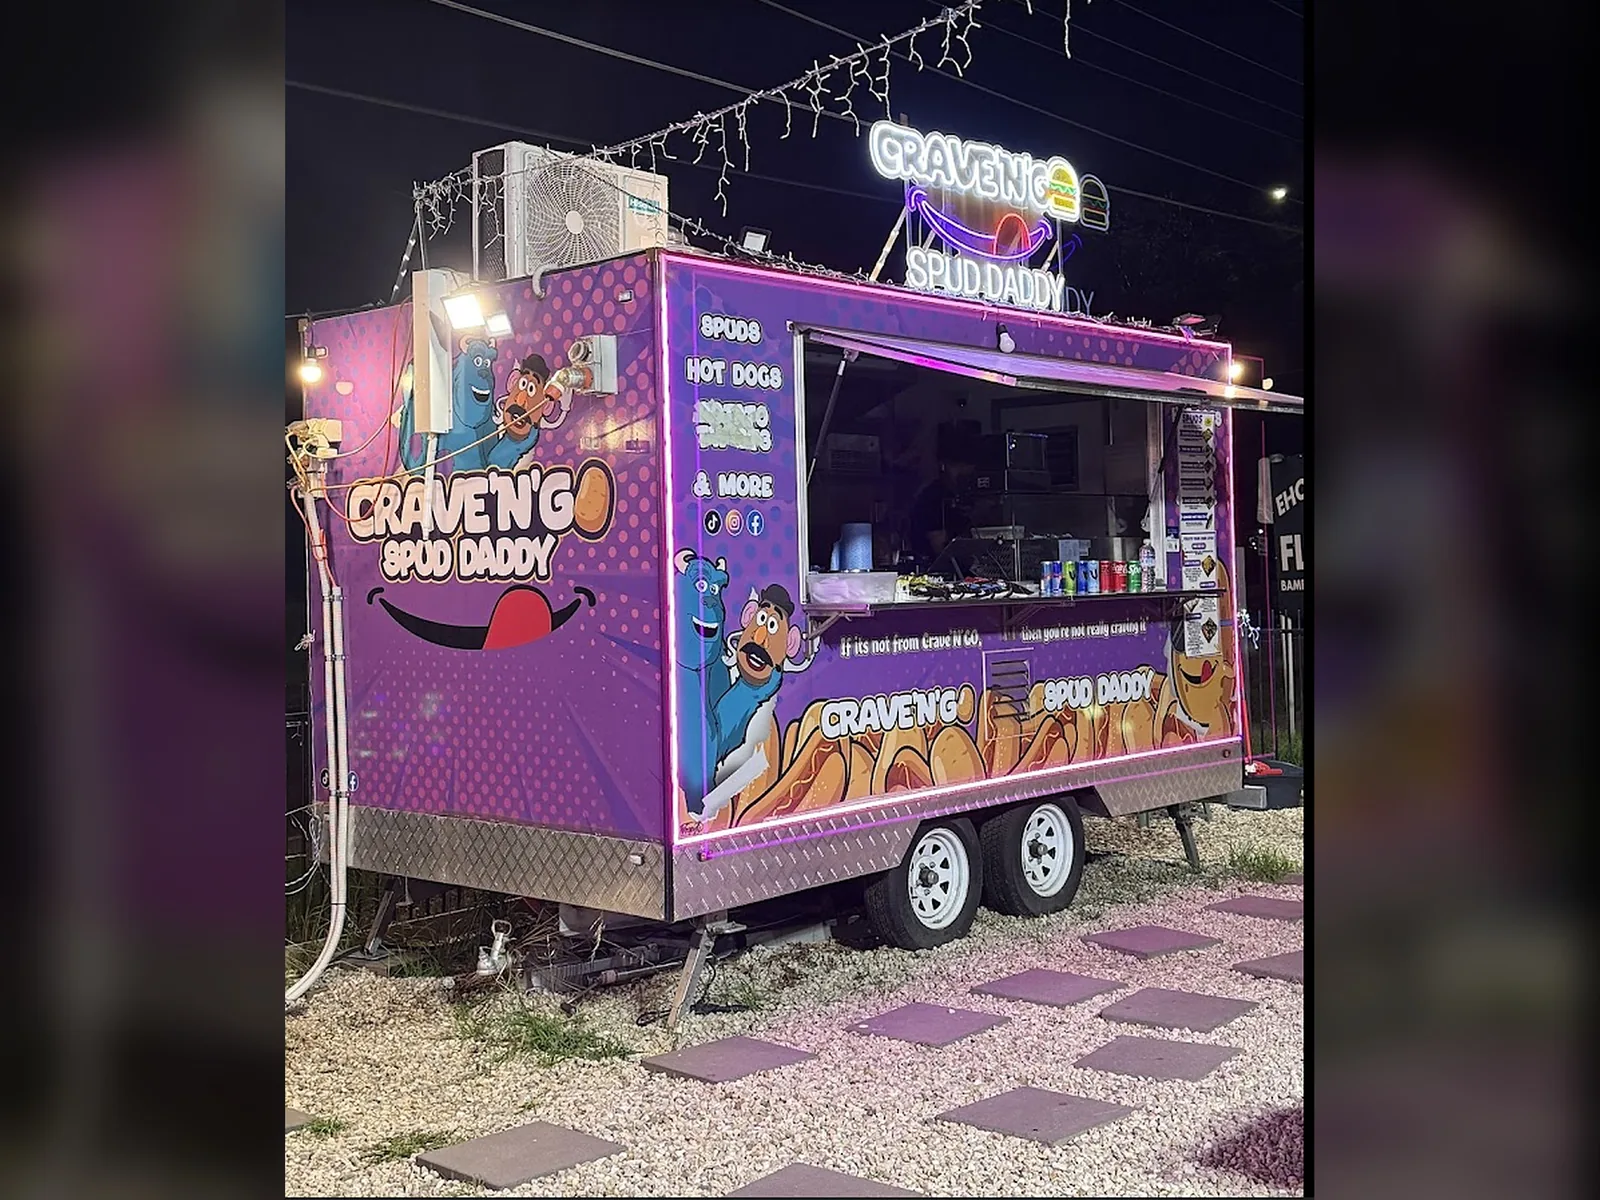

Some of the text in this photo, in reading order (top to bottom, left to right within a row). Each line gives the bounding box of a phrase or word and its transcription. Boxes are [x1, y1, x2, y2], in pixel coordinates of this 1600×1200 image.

[906, 246, 1066, 312] SPUD DADDY
[700, 314, 762, 344] SPUDS
[686, 357, 784, 391] HOT DOGS
[693, 470, 774, 499] & MORE
[383, 533, 557, 578] SPUD DADDY
[840, 637, 852, 657] If
[872, 636, 890, 653] not
[893, 634, 920, 653] from
[1022, 625, 1042, 641] then
[1044, 622, 1070, 642] you're
[1071, 623, 1086, 638] not
[1087, 621, 1109, 637] really
[1110, 617, 1138, 635] craving
[1043, 669, 1155, 711] SPUD DADDY
